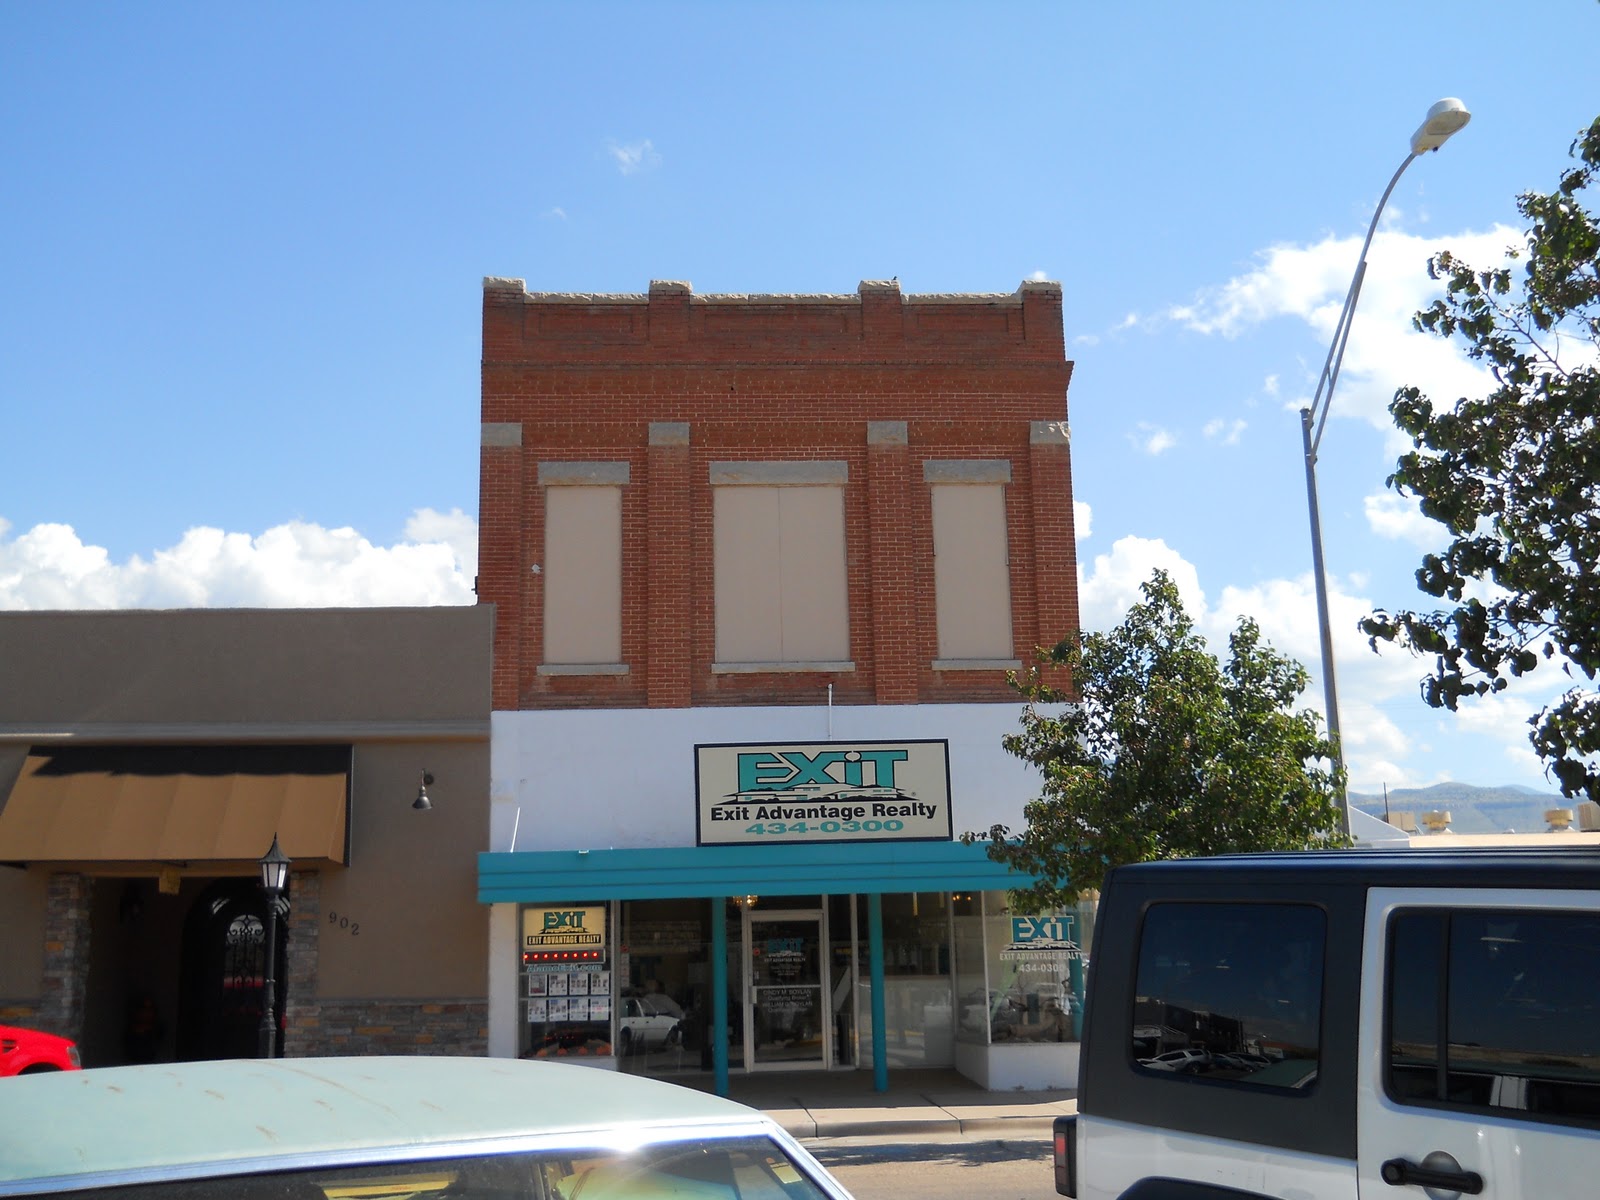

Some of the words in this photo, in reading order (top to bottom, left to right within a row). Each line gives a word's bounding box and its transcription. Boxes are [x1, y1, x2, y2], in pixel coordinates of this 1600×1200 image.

[711, 806, 749, 821] Exit
[756, 804, 865, 821] Advantage
[872, 802, 937, 819] Realty
[745, 819, 904, 835] 434-0300
[329, 911, 359, 936] 902
[528, 936, 542, 945] EXIT
[543, 935, 577, 944] ADVANTAGE
[578, 935, 600, 943] REALTY
[1000, 952, 1015, 960] EXIT
[1016, 952, 1056, 960] ADVANTAGE
[1058, 952, 1083, 960] REALTY
